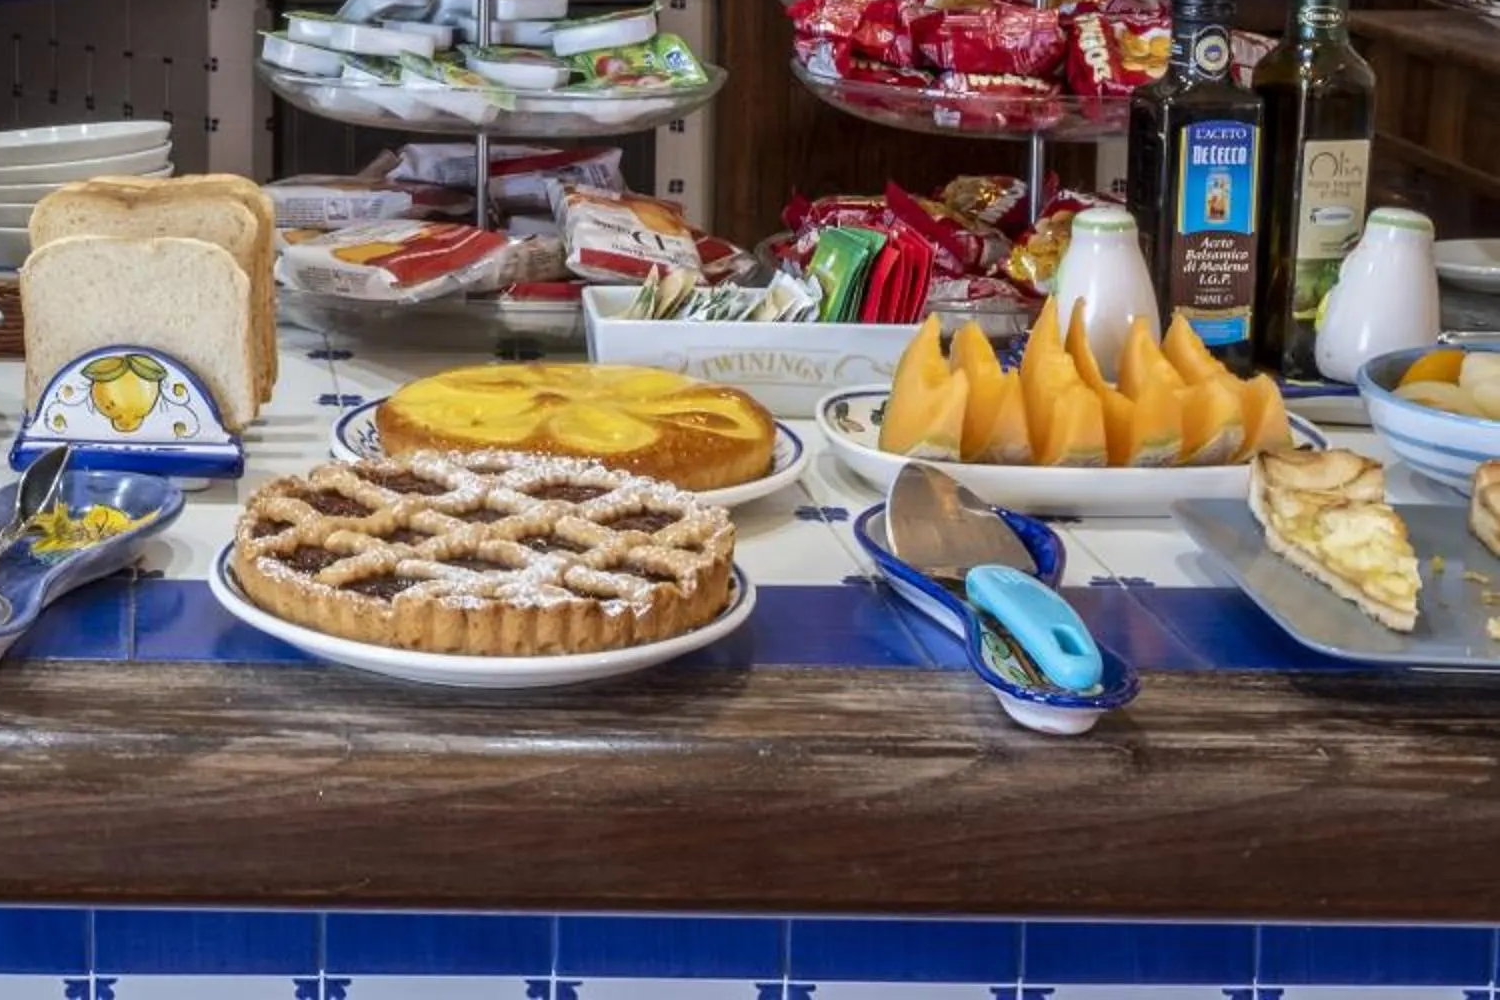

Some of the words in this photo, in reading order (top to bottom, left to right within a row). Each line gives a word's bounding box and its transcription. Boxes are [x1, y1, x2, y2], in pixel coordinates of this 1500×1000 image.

[1185, 248, 1249, 262] Balsamico
[1183, 260, 1196, 273] di
[1198, 259, 1249, 273] Modena
[702, 352, 824, 380] TWININGS
